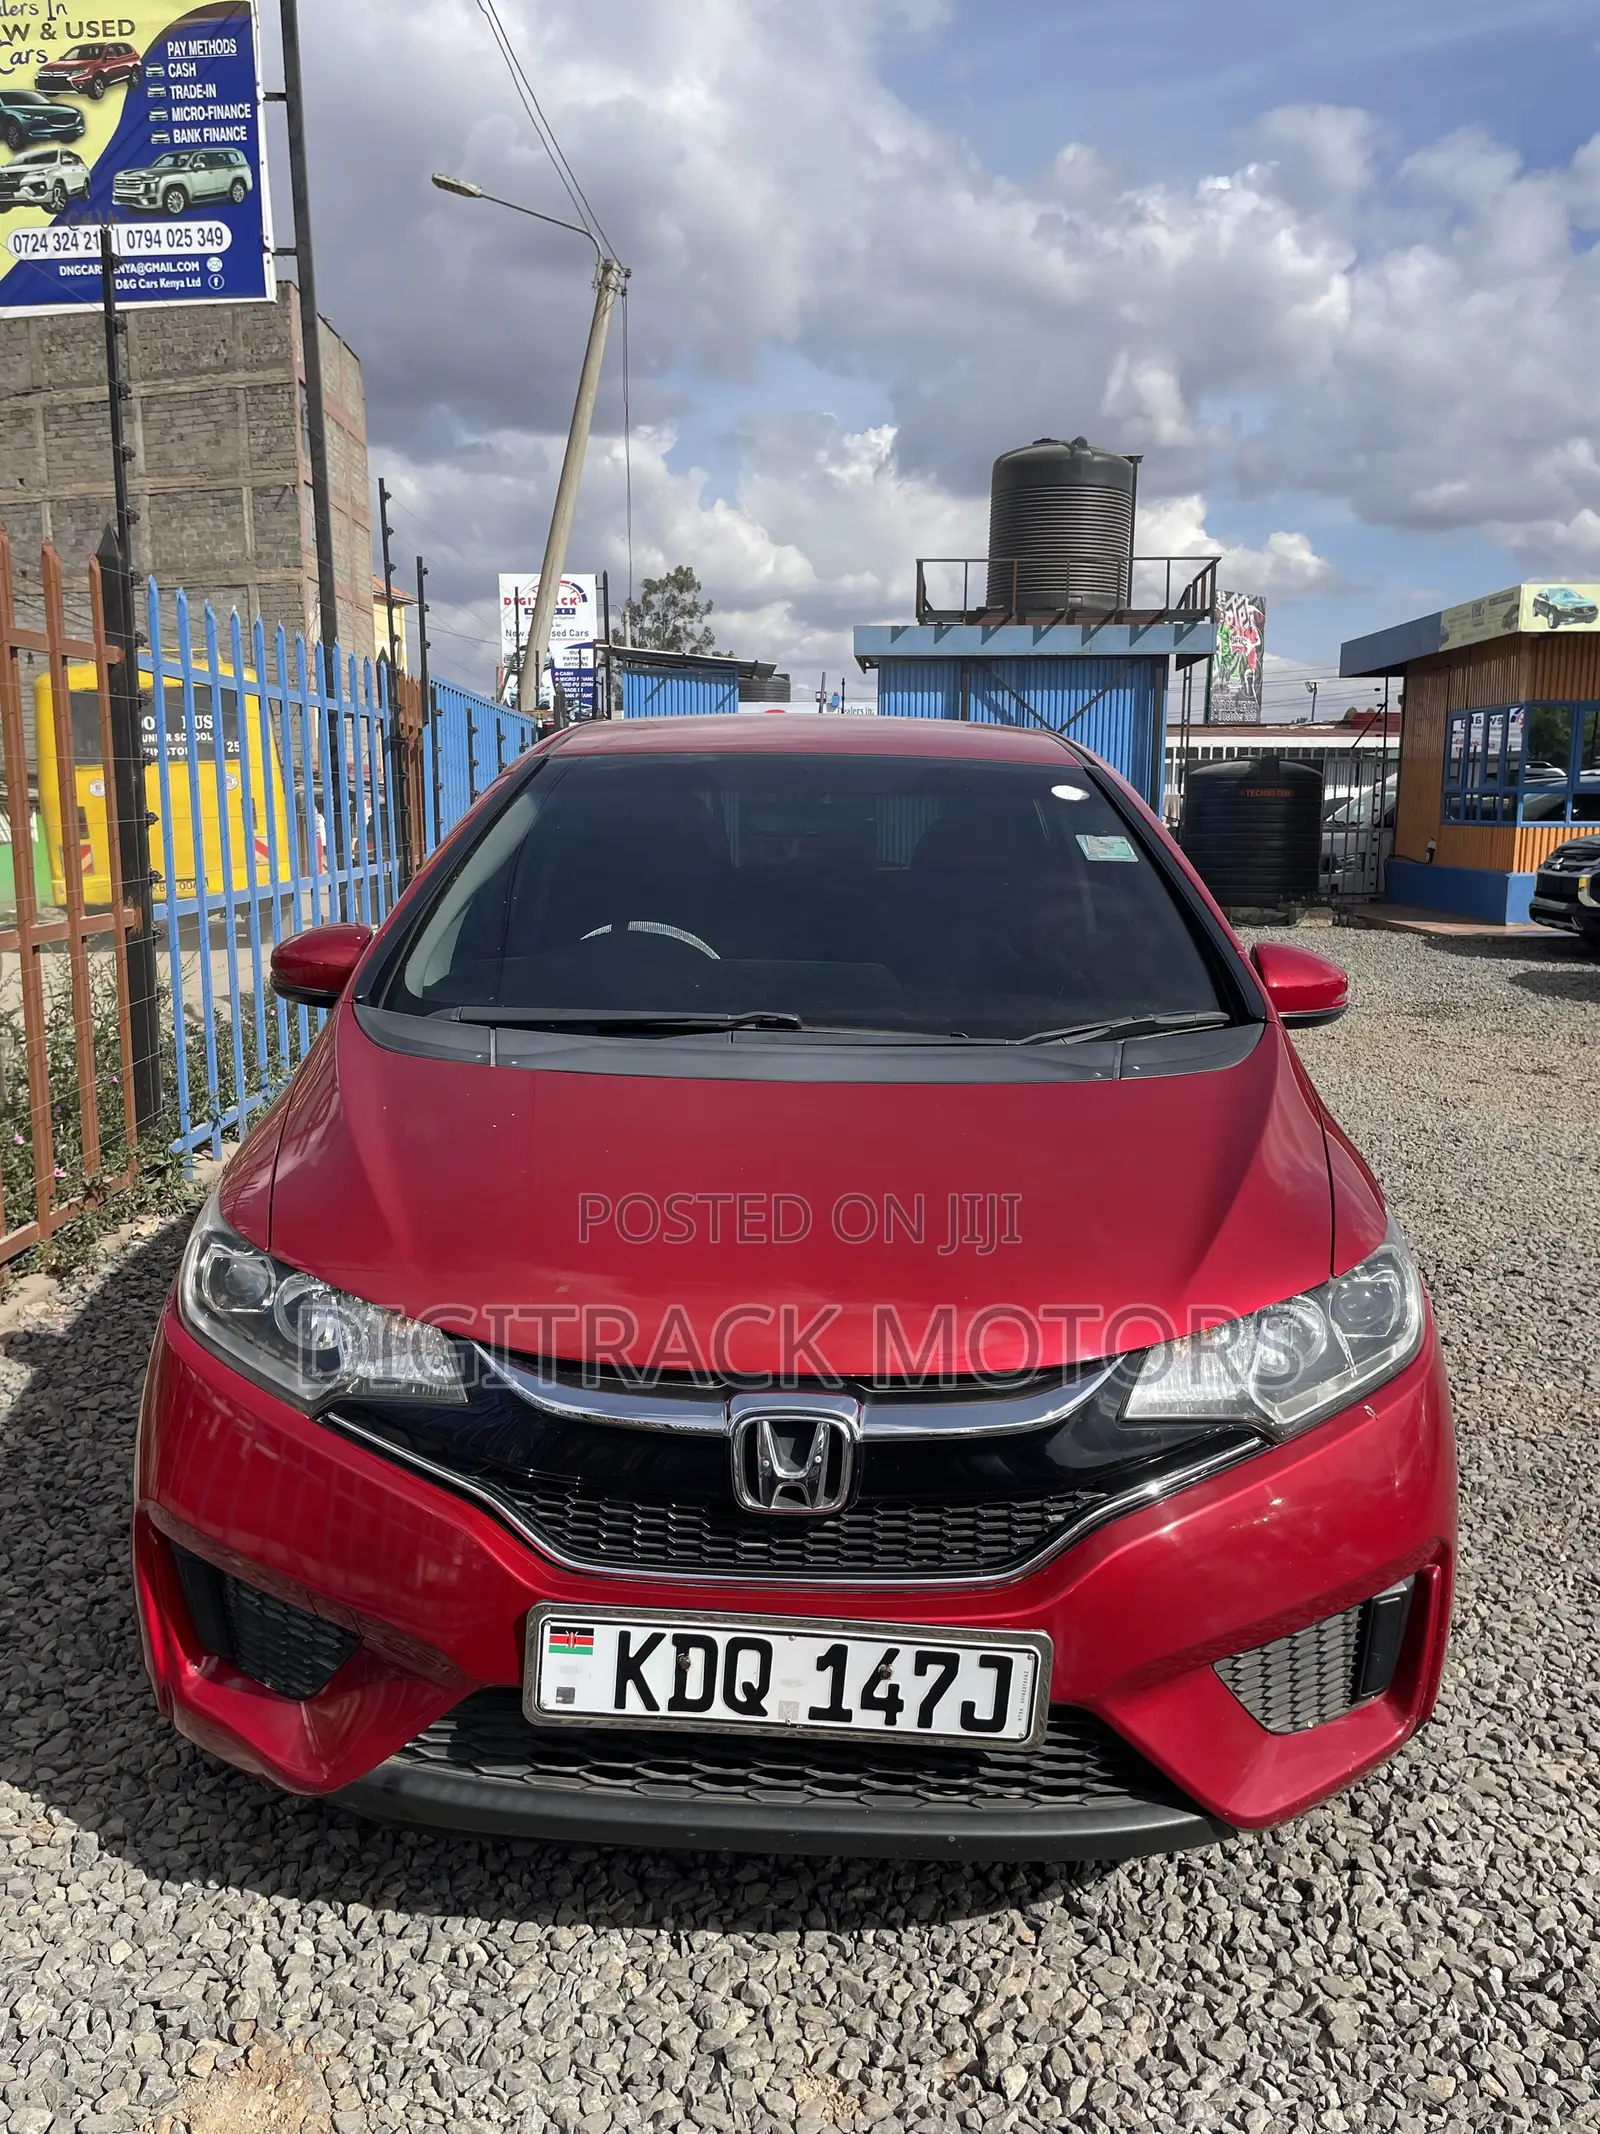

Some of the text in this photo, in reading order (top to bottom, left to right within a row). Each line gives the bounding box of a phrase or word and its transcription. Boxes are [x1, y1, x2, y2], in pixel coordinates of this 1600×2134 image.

[40, 22, 57, 40] &
[65, 19, 136, 39] USED
[167, 38, 237, 57] PAY METHODS
[168, 62, 197, 78] CASH
[170, 83, 217, 99] TRADE-IN
[171, 103, 252, 122] MICRO-FINANCE
[173, 125, 248, 144] BANK FINANCE
[13, 226, 224, 253] 0724 324 21 0794 025 349
[115, 276, 201, 290] D&G Cars Kenya Ltd
[551, 629, 567, 637] sed
[569, 629, 590, 637] Cars
[613, 1629, 1013, 1733] KDQ 147J
